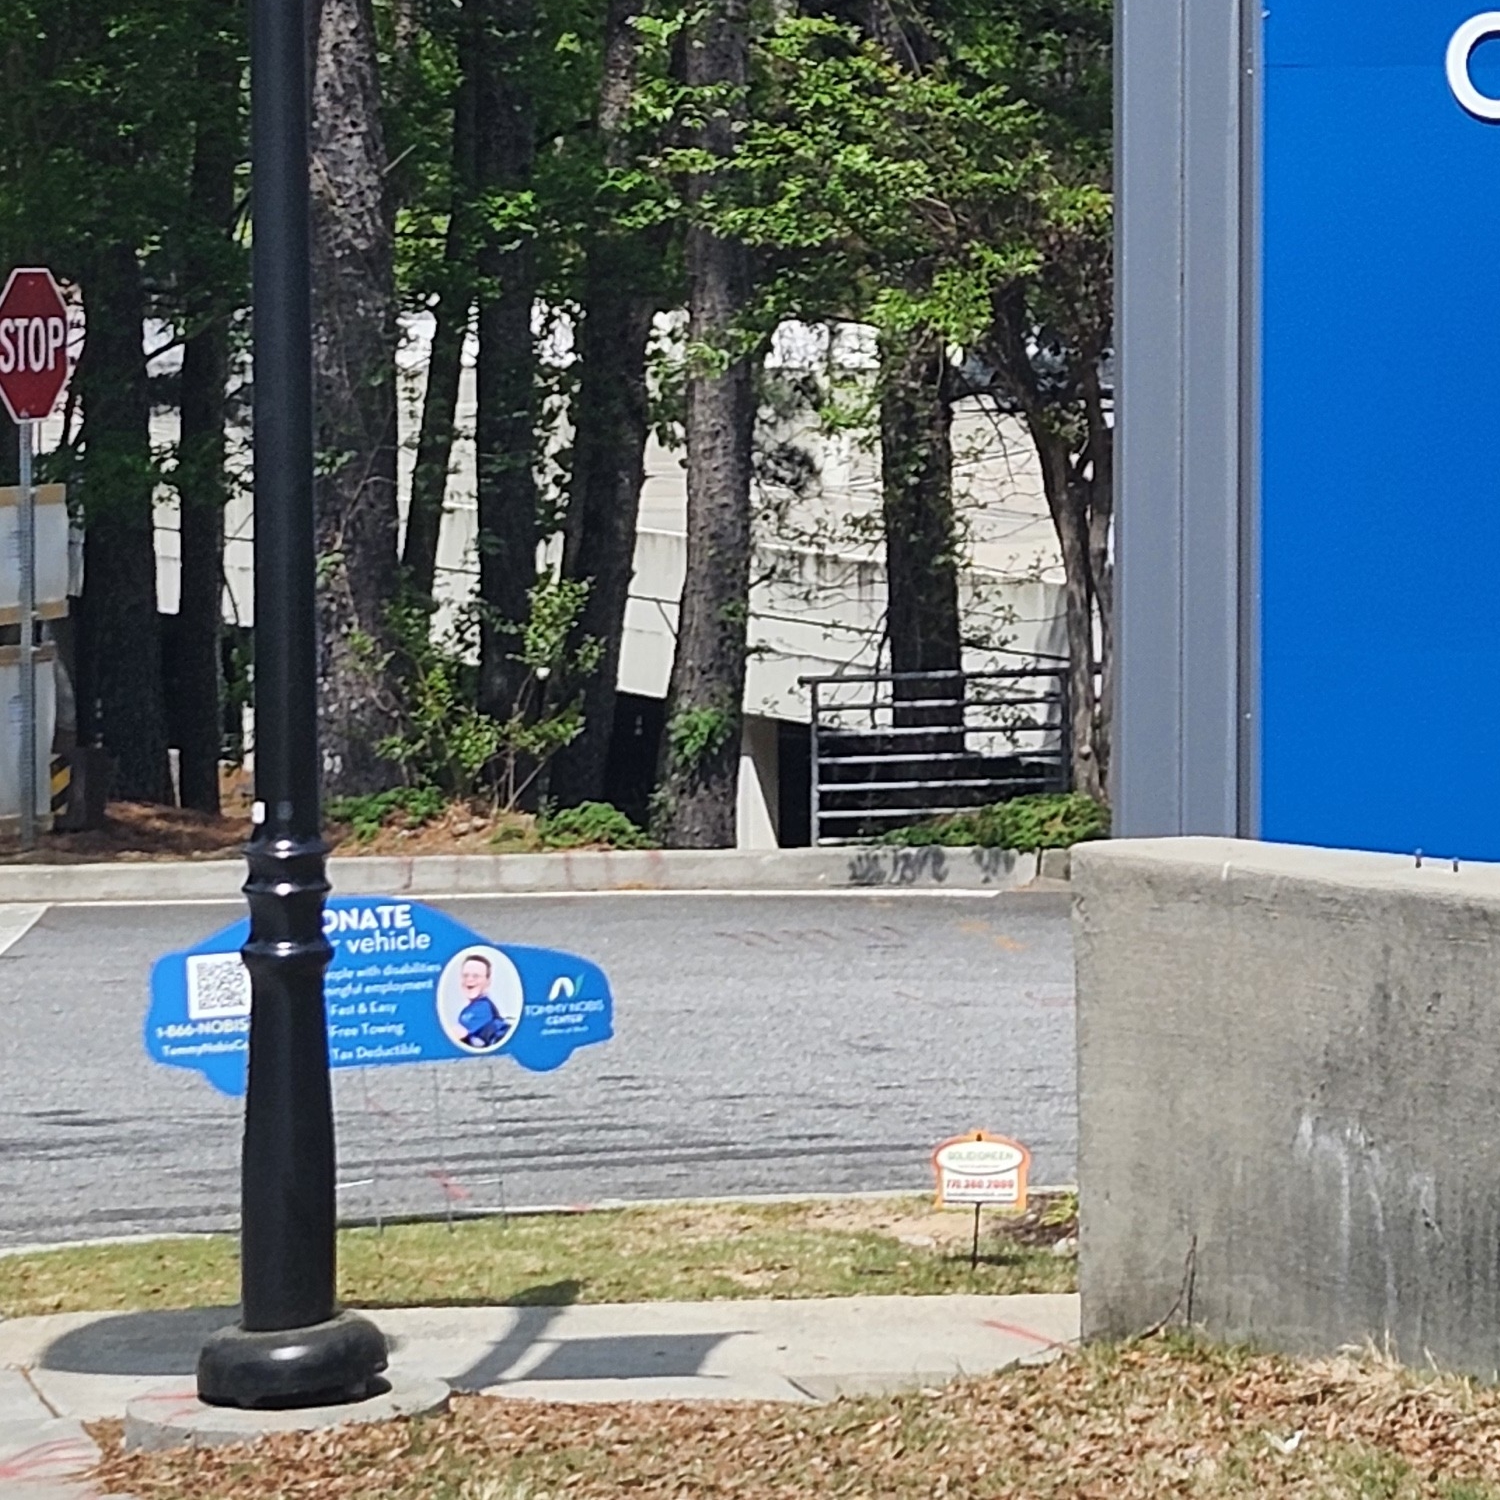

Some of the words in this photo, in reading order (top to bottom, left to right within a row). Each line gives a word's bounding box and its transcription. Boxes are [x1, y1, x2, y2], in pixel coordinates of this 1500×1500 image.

[0, 317, 64, 373] STOP
[322, 904, 413, 934] ONATE
[346, 926, 431, 954] vehicle
[330, 1004, 355, 1016] Fast
[370, 1001, 398, 1016] Easy
[525, 1003, 567, 1016] TOMMY
[569, 999, 604, 1012] NOBIS
[545, 1013, 584, 1025] CENTER
[329, 1025, 359, 1038] Free
[361, 1022, 406, 1036] Towing
[331, 1047, 353, 1060] Tax
[356, 1043, 422, 1059] Deductible
